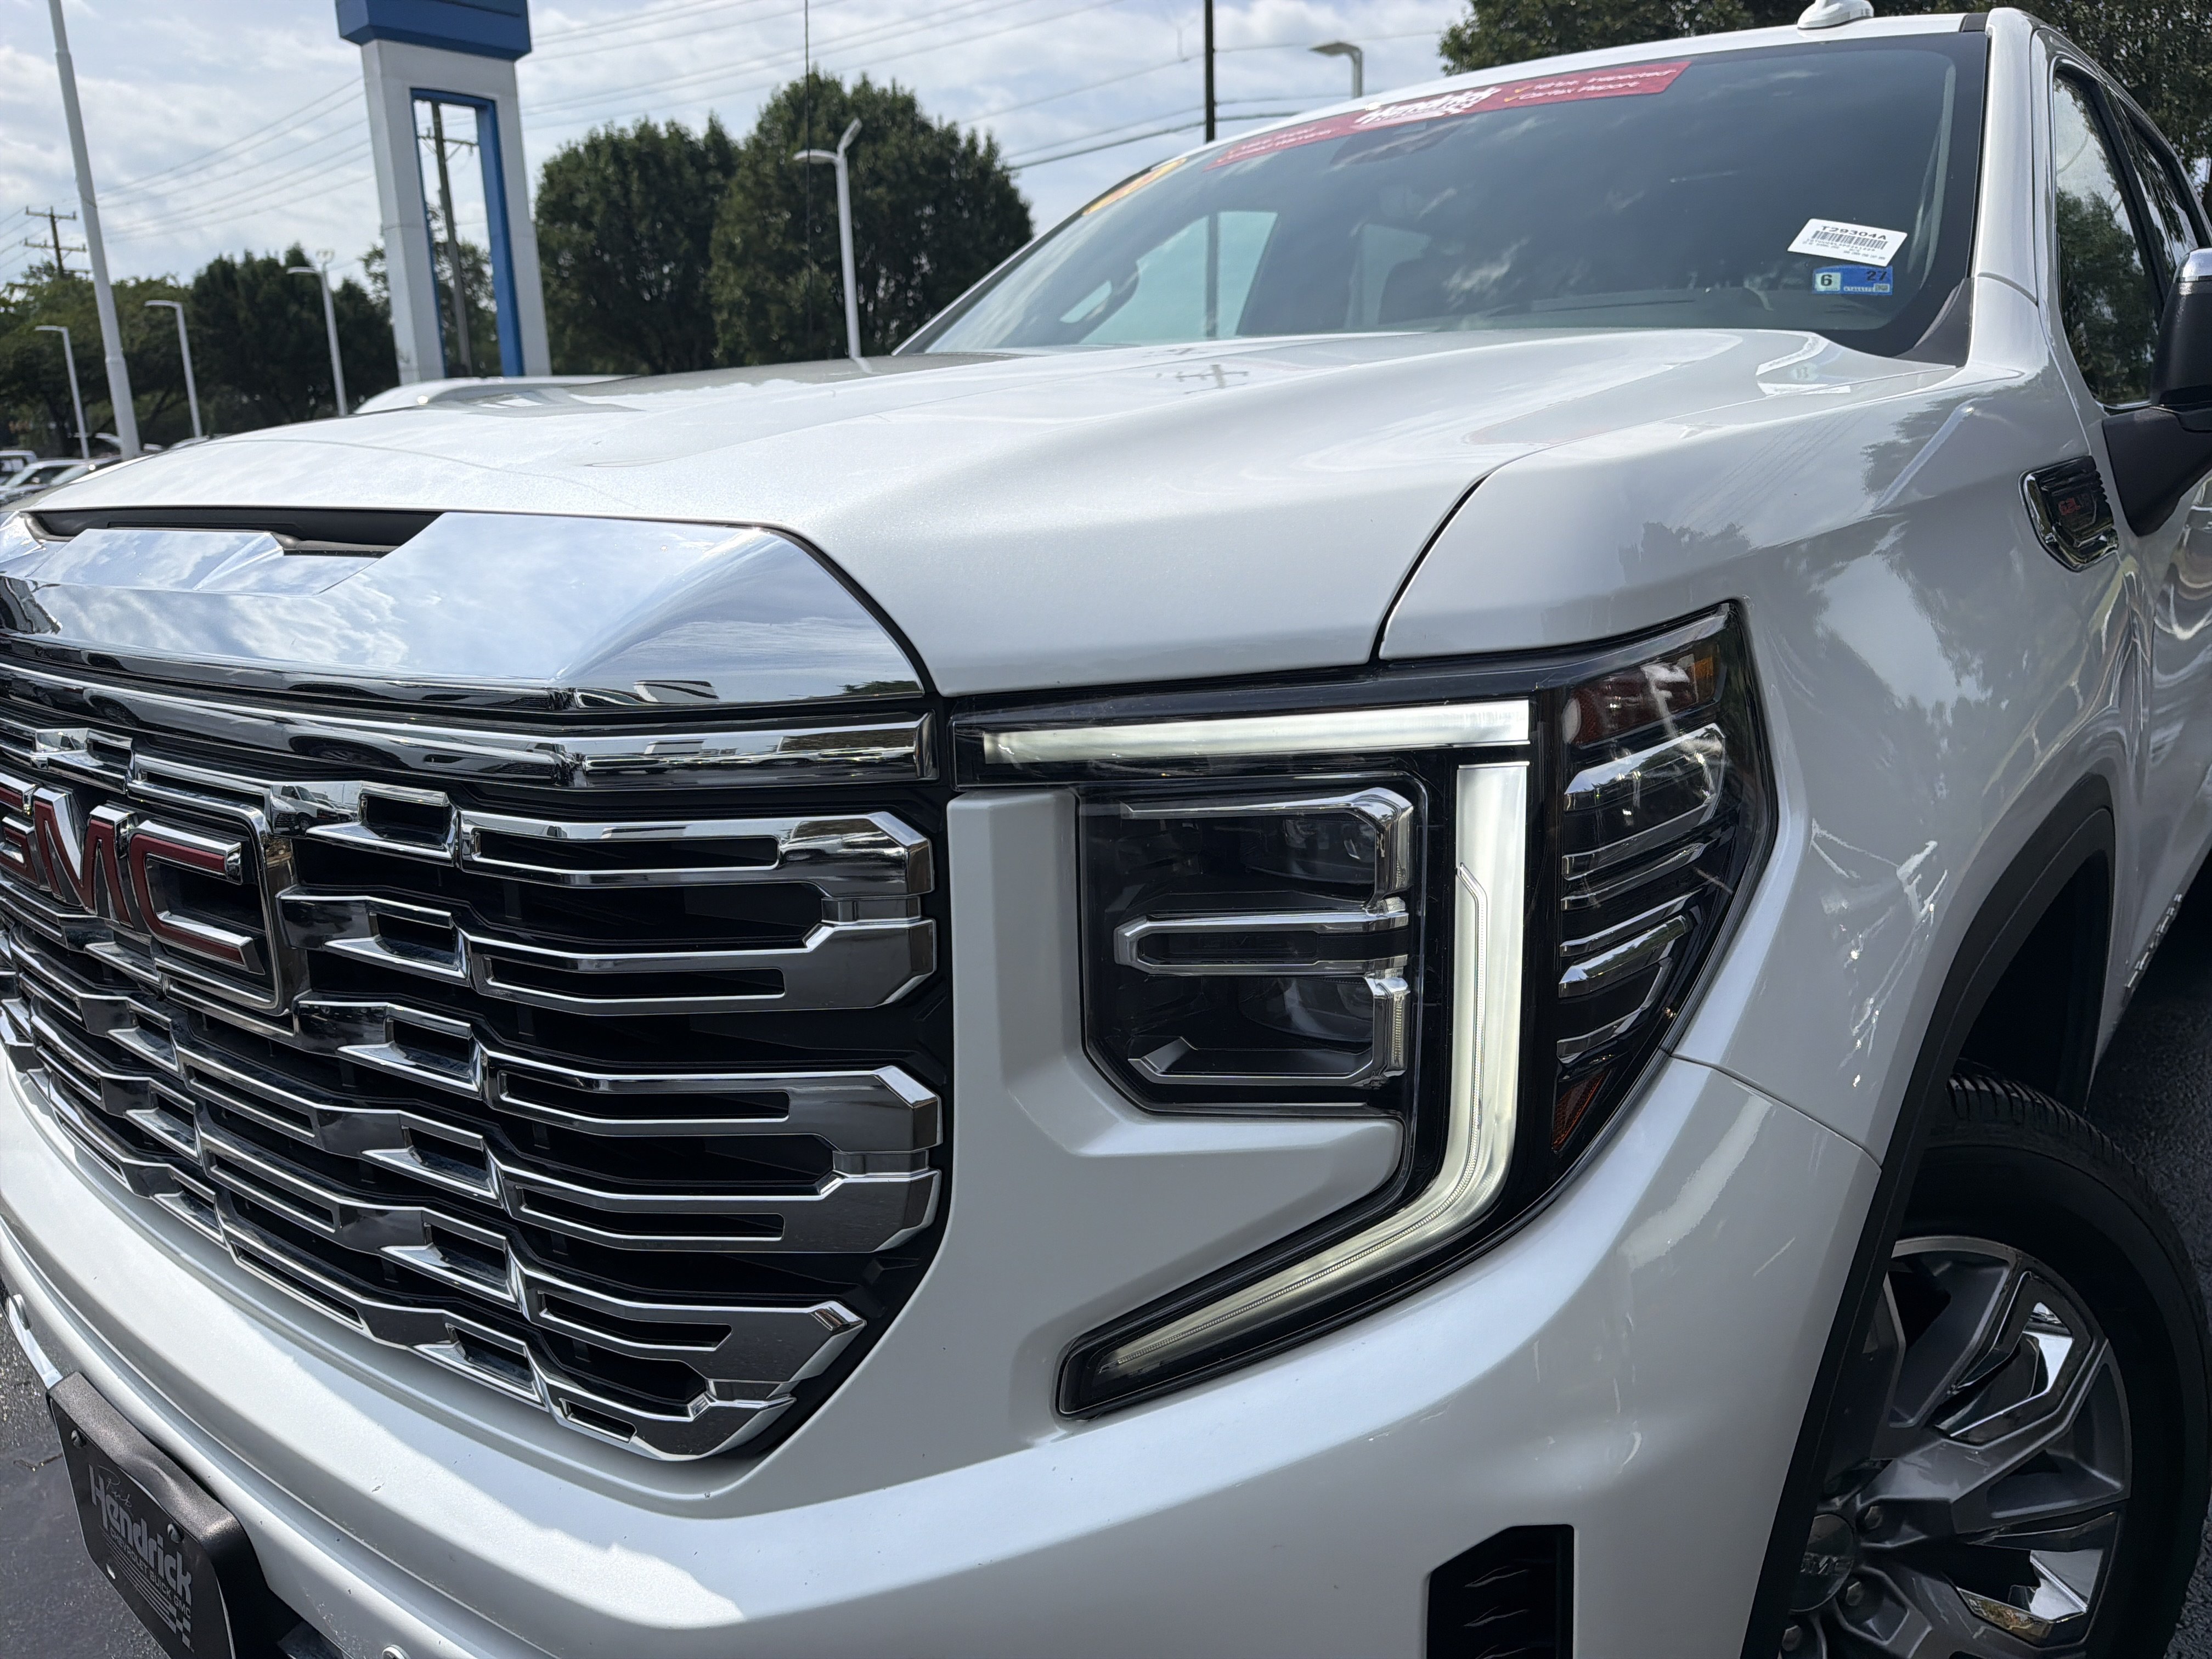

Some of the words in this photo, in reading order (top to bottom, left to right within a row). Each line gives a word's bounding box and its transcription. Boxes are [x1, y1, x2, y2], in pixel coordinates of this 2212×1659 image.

[1821, 225, 1887, 240] T29304A
[1821, 274, 1833, 286] 6
[88, 1464, 191, 1606] Hendrick
[110, 1527, 149, 1575] CHEVROLET
[150, 1571, 172, 1600] BUICK
[173, 1595, 191, 1620] GMC
